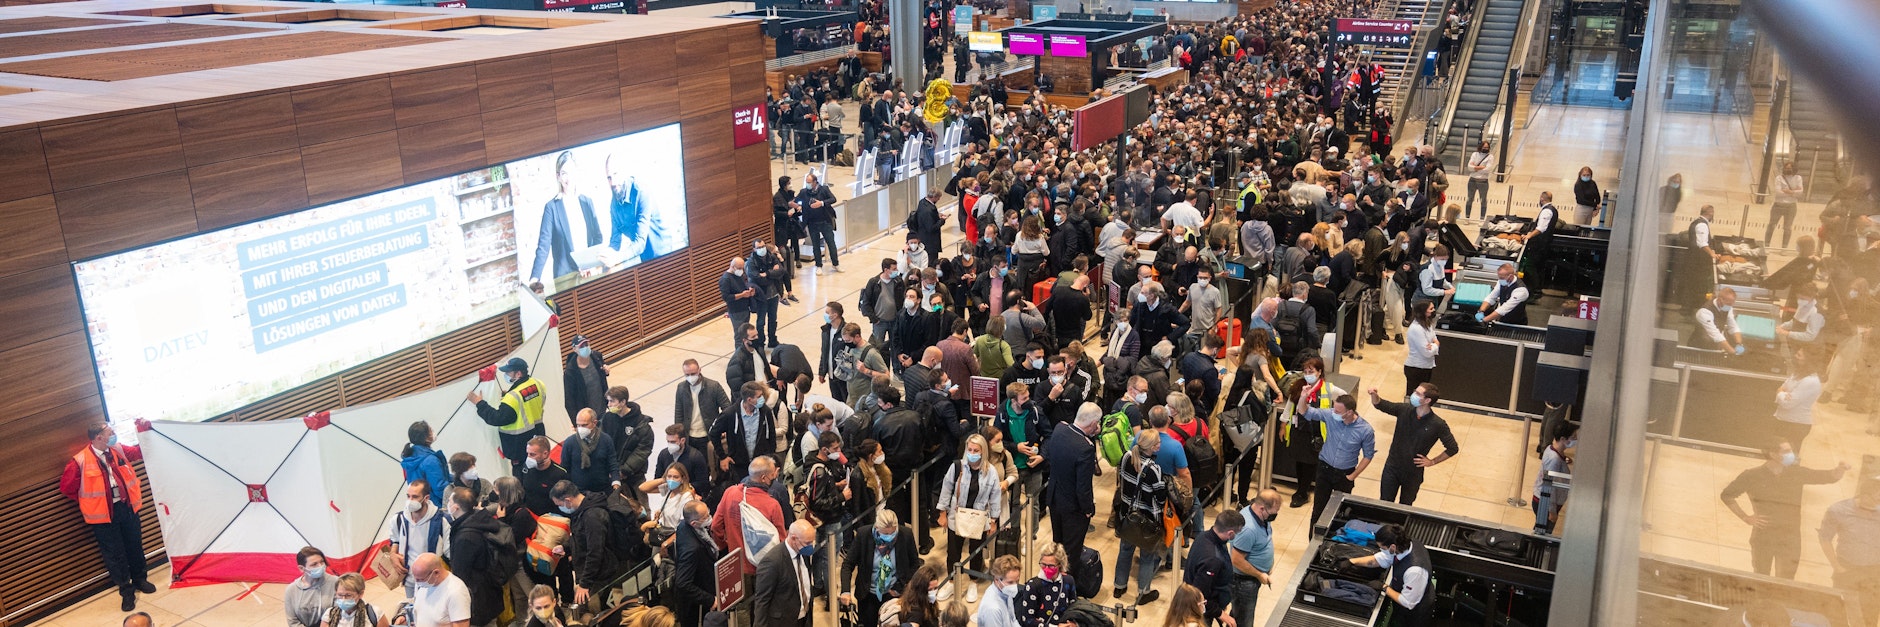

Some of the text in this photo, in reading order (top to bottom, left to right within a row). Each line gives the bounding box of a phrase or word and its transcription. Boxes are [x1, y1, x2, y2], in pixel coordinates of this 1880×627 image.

[736, 110, 751, 118] Check-in
[752, 107, 764, 135] 4
[247, 203, 431, 261] MEHR ERFOLG FÜR IHRE IDEEN.
[253, 231, 422, 290] MIT IHRER STEUERBERATUNG
[257, 270, 381, 318] UND DEN DIGITALEN
[262, 291, 401, 346] LÖSUNGEN VON DATEV.
[143, 329, 209, 363] DATEV
